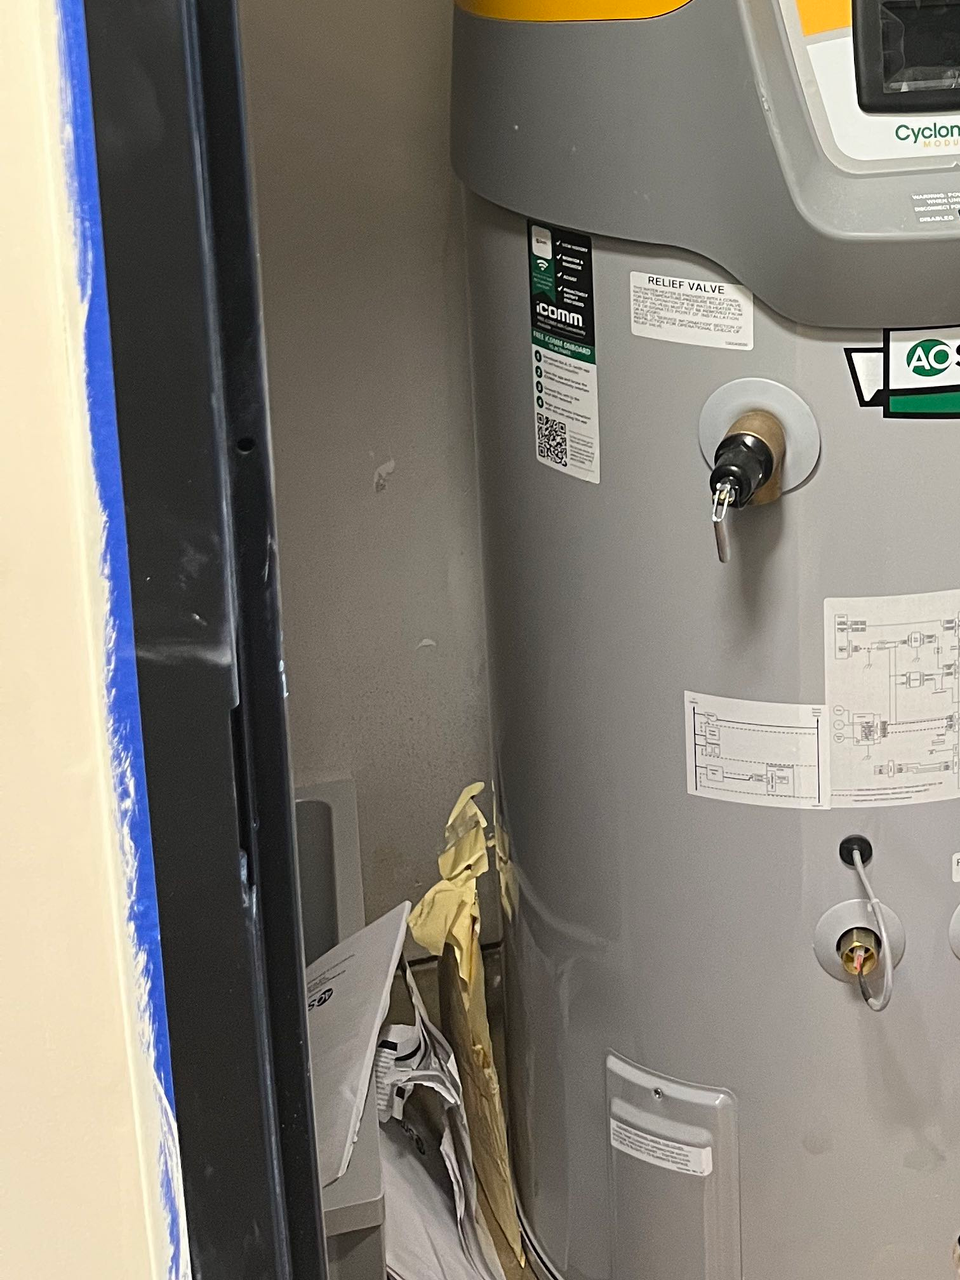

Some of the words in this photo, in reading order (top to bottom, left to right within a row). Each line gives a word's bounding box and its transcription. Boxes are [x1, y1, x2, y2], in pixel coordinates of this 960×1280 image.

[914, 204, 950, 212] DISCONNECT
[648, 276, 685, 290] RELIEF
[688, 281, 725, 295] VALVE
